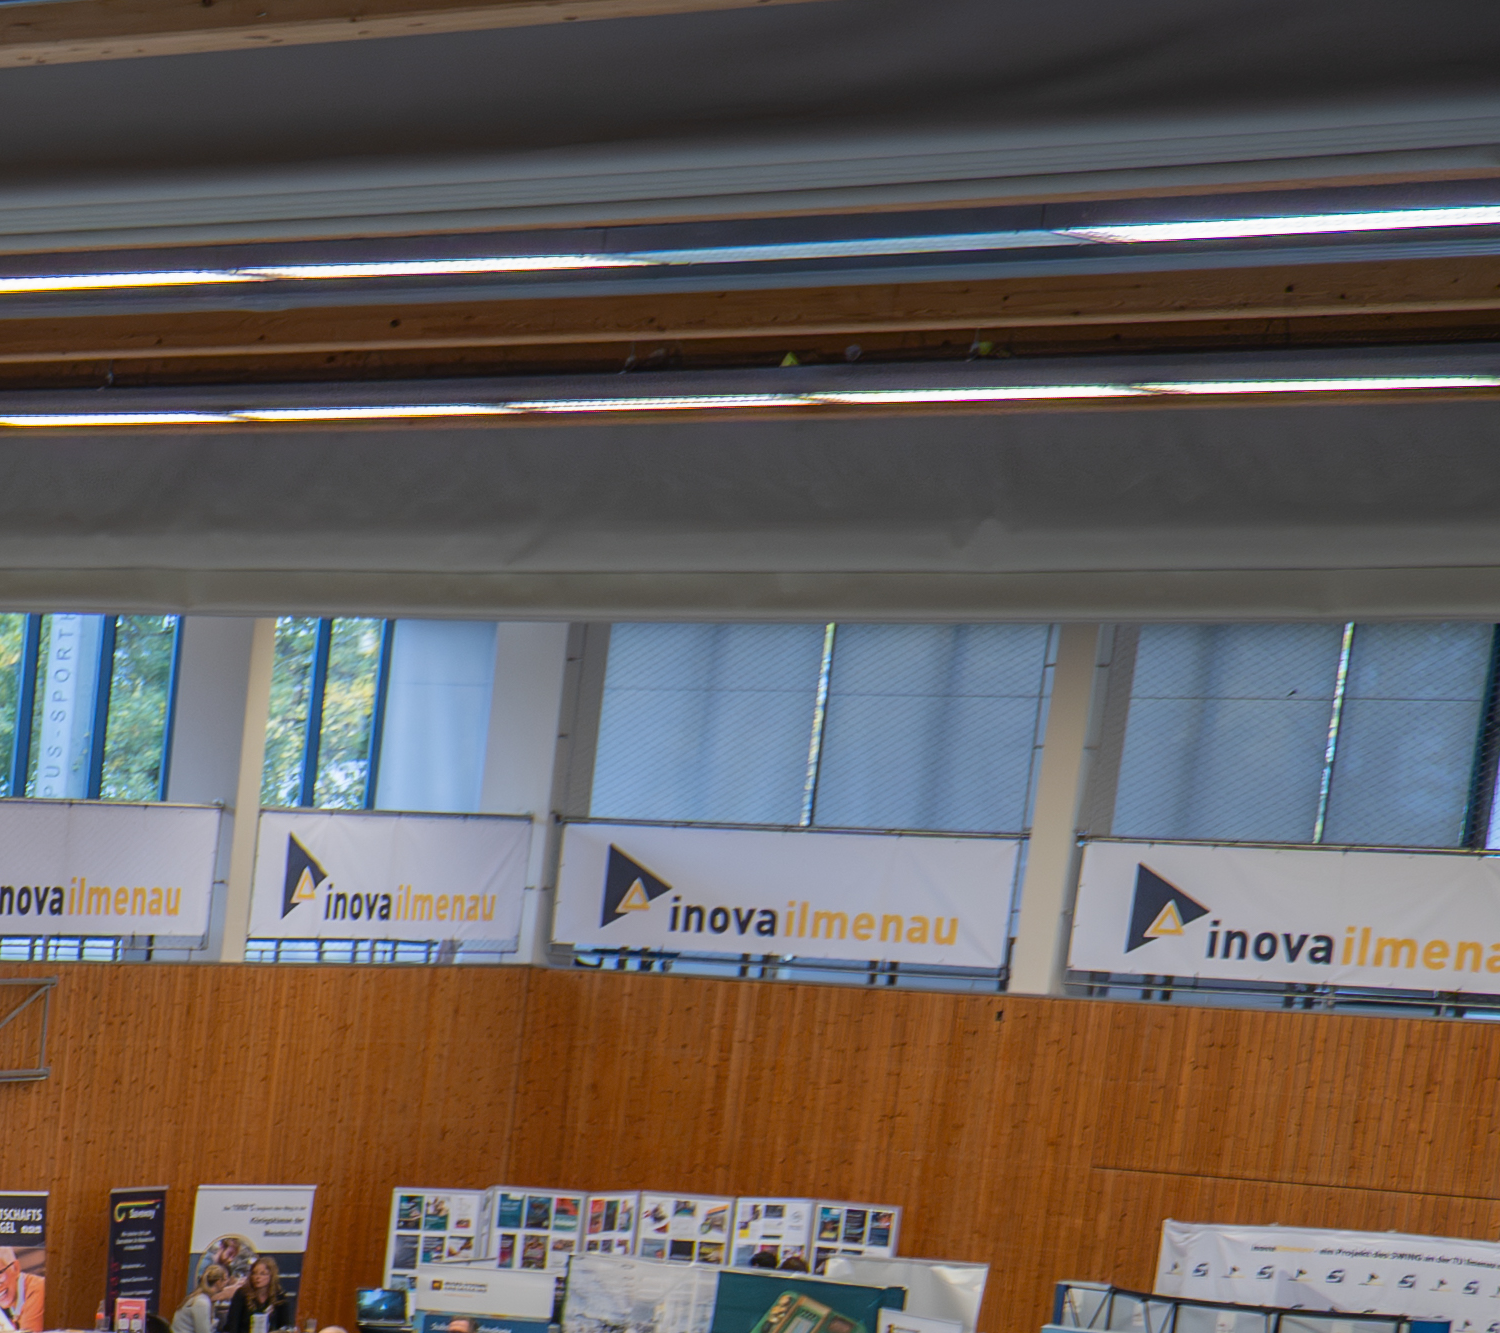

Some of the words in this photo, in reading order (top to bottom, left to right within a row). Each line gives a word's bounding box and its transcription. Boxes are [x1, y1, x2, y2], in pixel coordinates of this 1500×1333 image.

[324, 883, 496, 922] inovailmenau
[669, 896, 959, 946] inovailmenau
[1205, 919, 1500, 974] inovailmena
